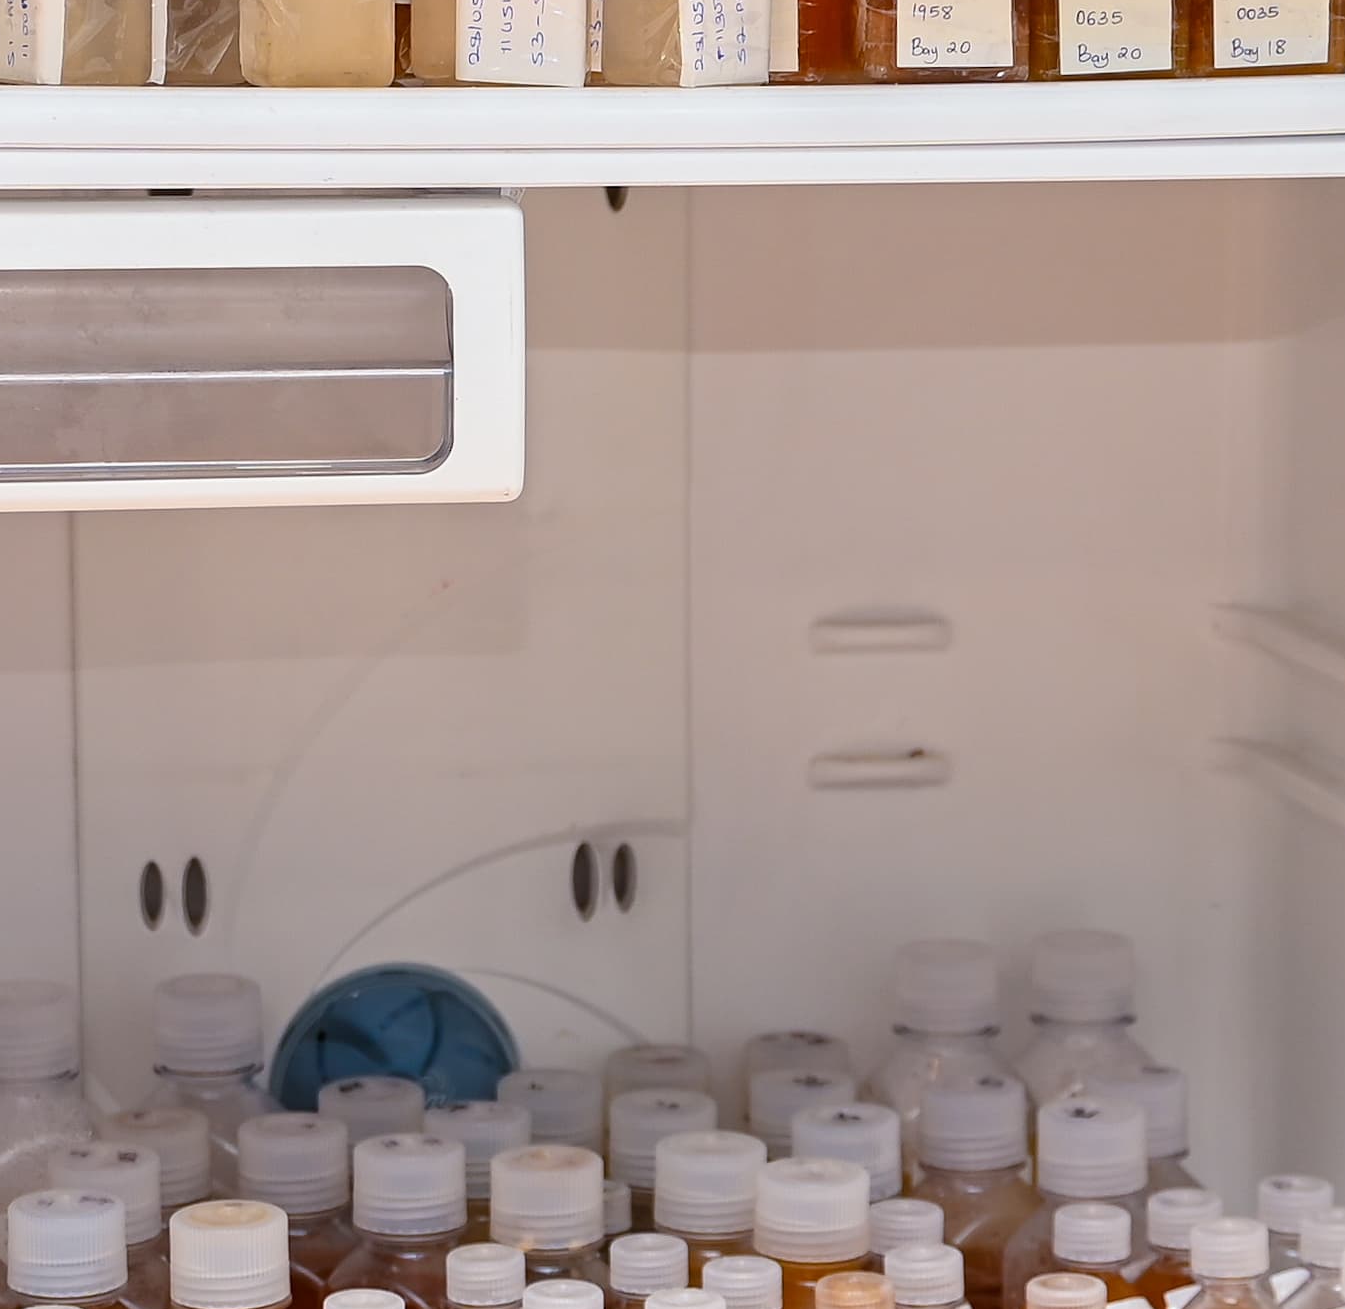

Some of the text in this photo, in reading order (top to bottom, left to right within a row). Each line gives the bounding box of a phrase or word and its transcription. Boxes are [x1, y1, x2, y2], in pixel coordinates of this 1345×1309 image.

[912, 4, 953, 21] 1958
[1076, 10, 1123, 26] 0635
[1237, 5, 1279, 21] 0035
[911, 39, 971, 63] Bay 20
[1078, 44, 1142, 66] Bay 20
[1231, 39, 1286, 62] Bay 18
